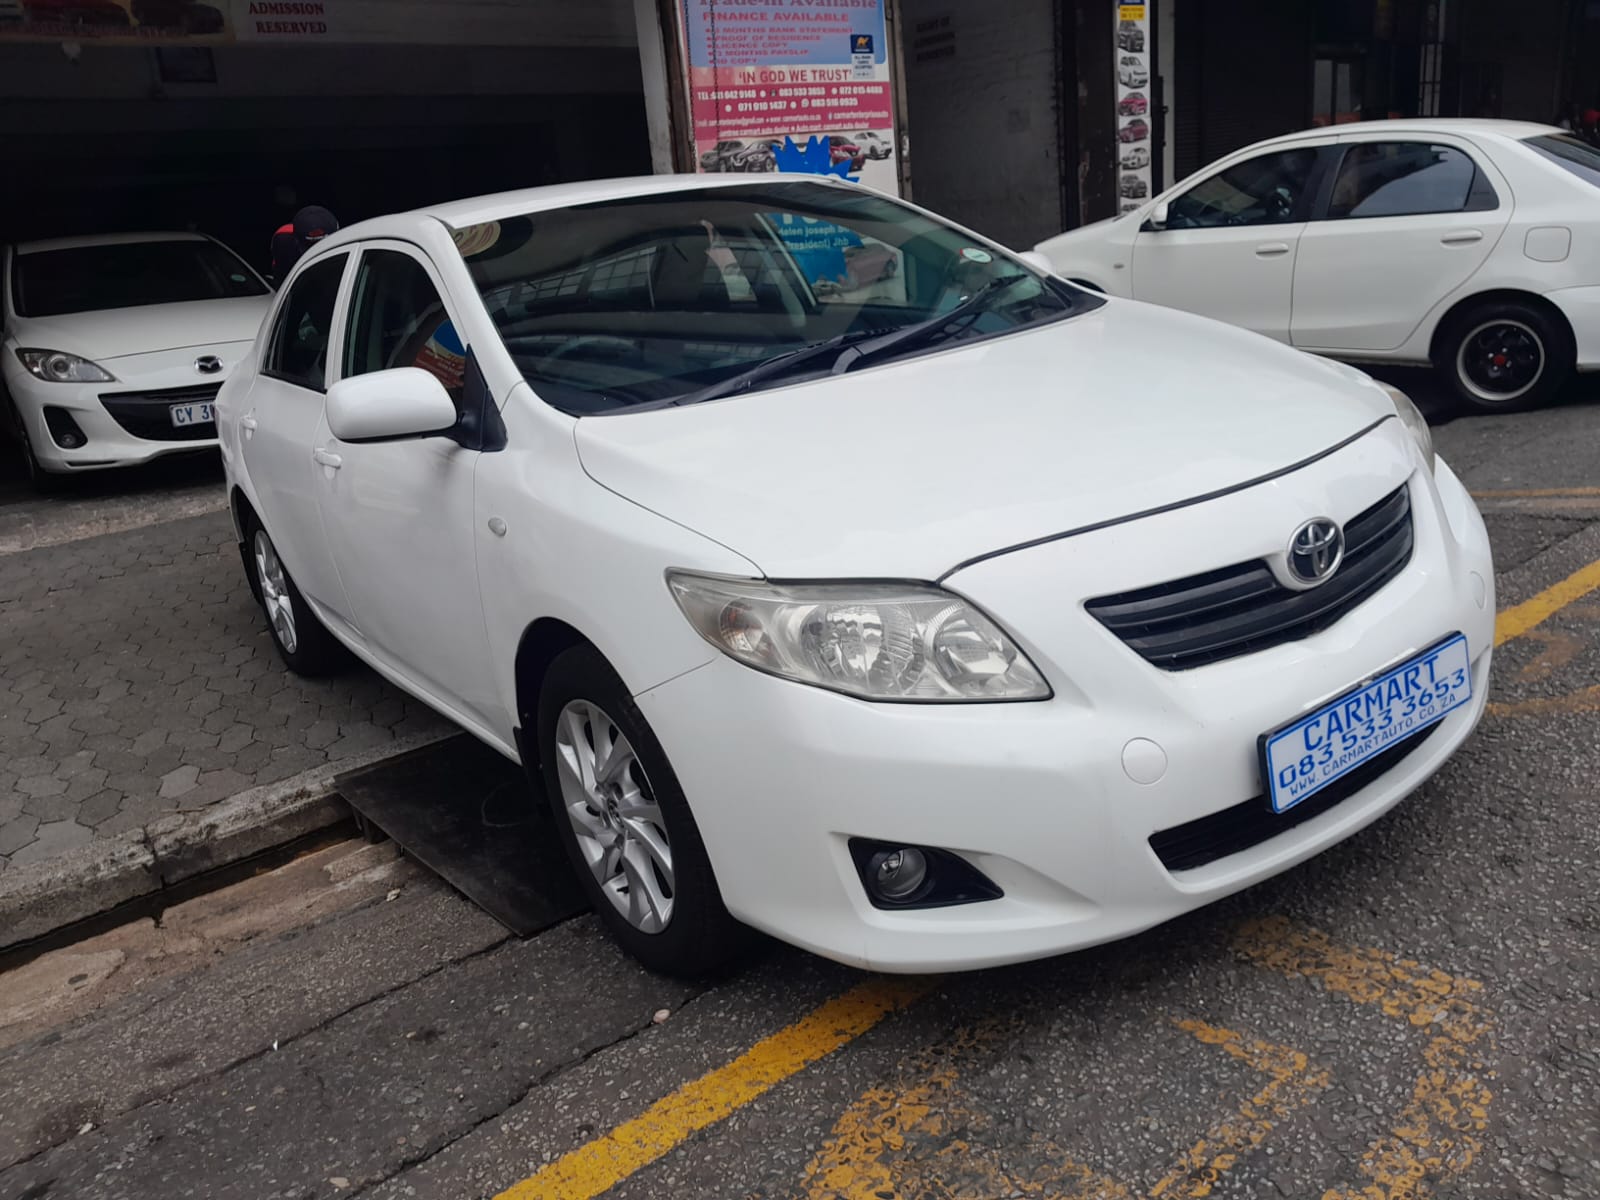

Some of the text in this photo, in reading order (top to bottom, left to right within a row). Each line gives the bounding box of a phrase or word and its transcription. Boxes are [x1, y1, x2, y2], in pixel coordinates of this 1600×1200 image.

[249, 2, 324, 15] ADMISSION
[703, 12, 849, 22] FINANCE AVAILABLE
[256, 21, 327, 34] RESERVED
[760, 71, 785, 83] GOD
[789, 70, 808, 82] WE
[175, 407, 193, 424] CY
[1303, 655, 1439, 751] CARMART
[1279, 668, 1465, 788] 083 533 3653
